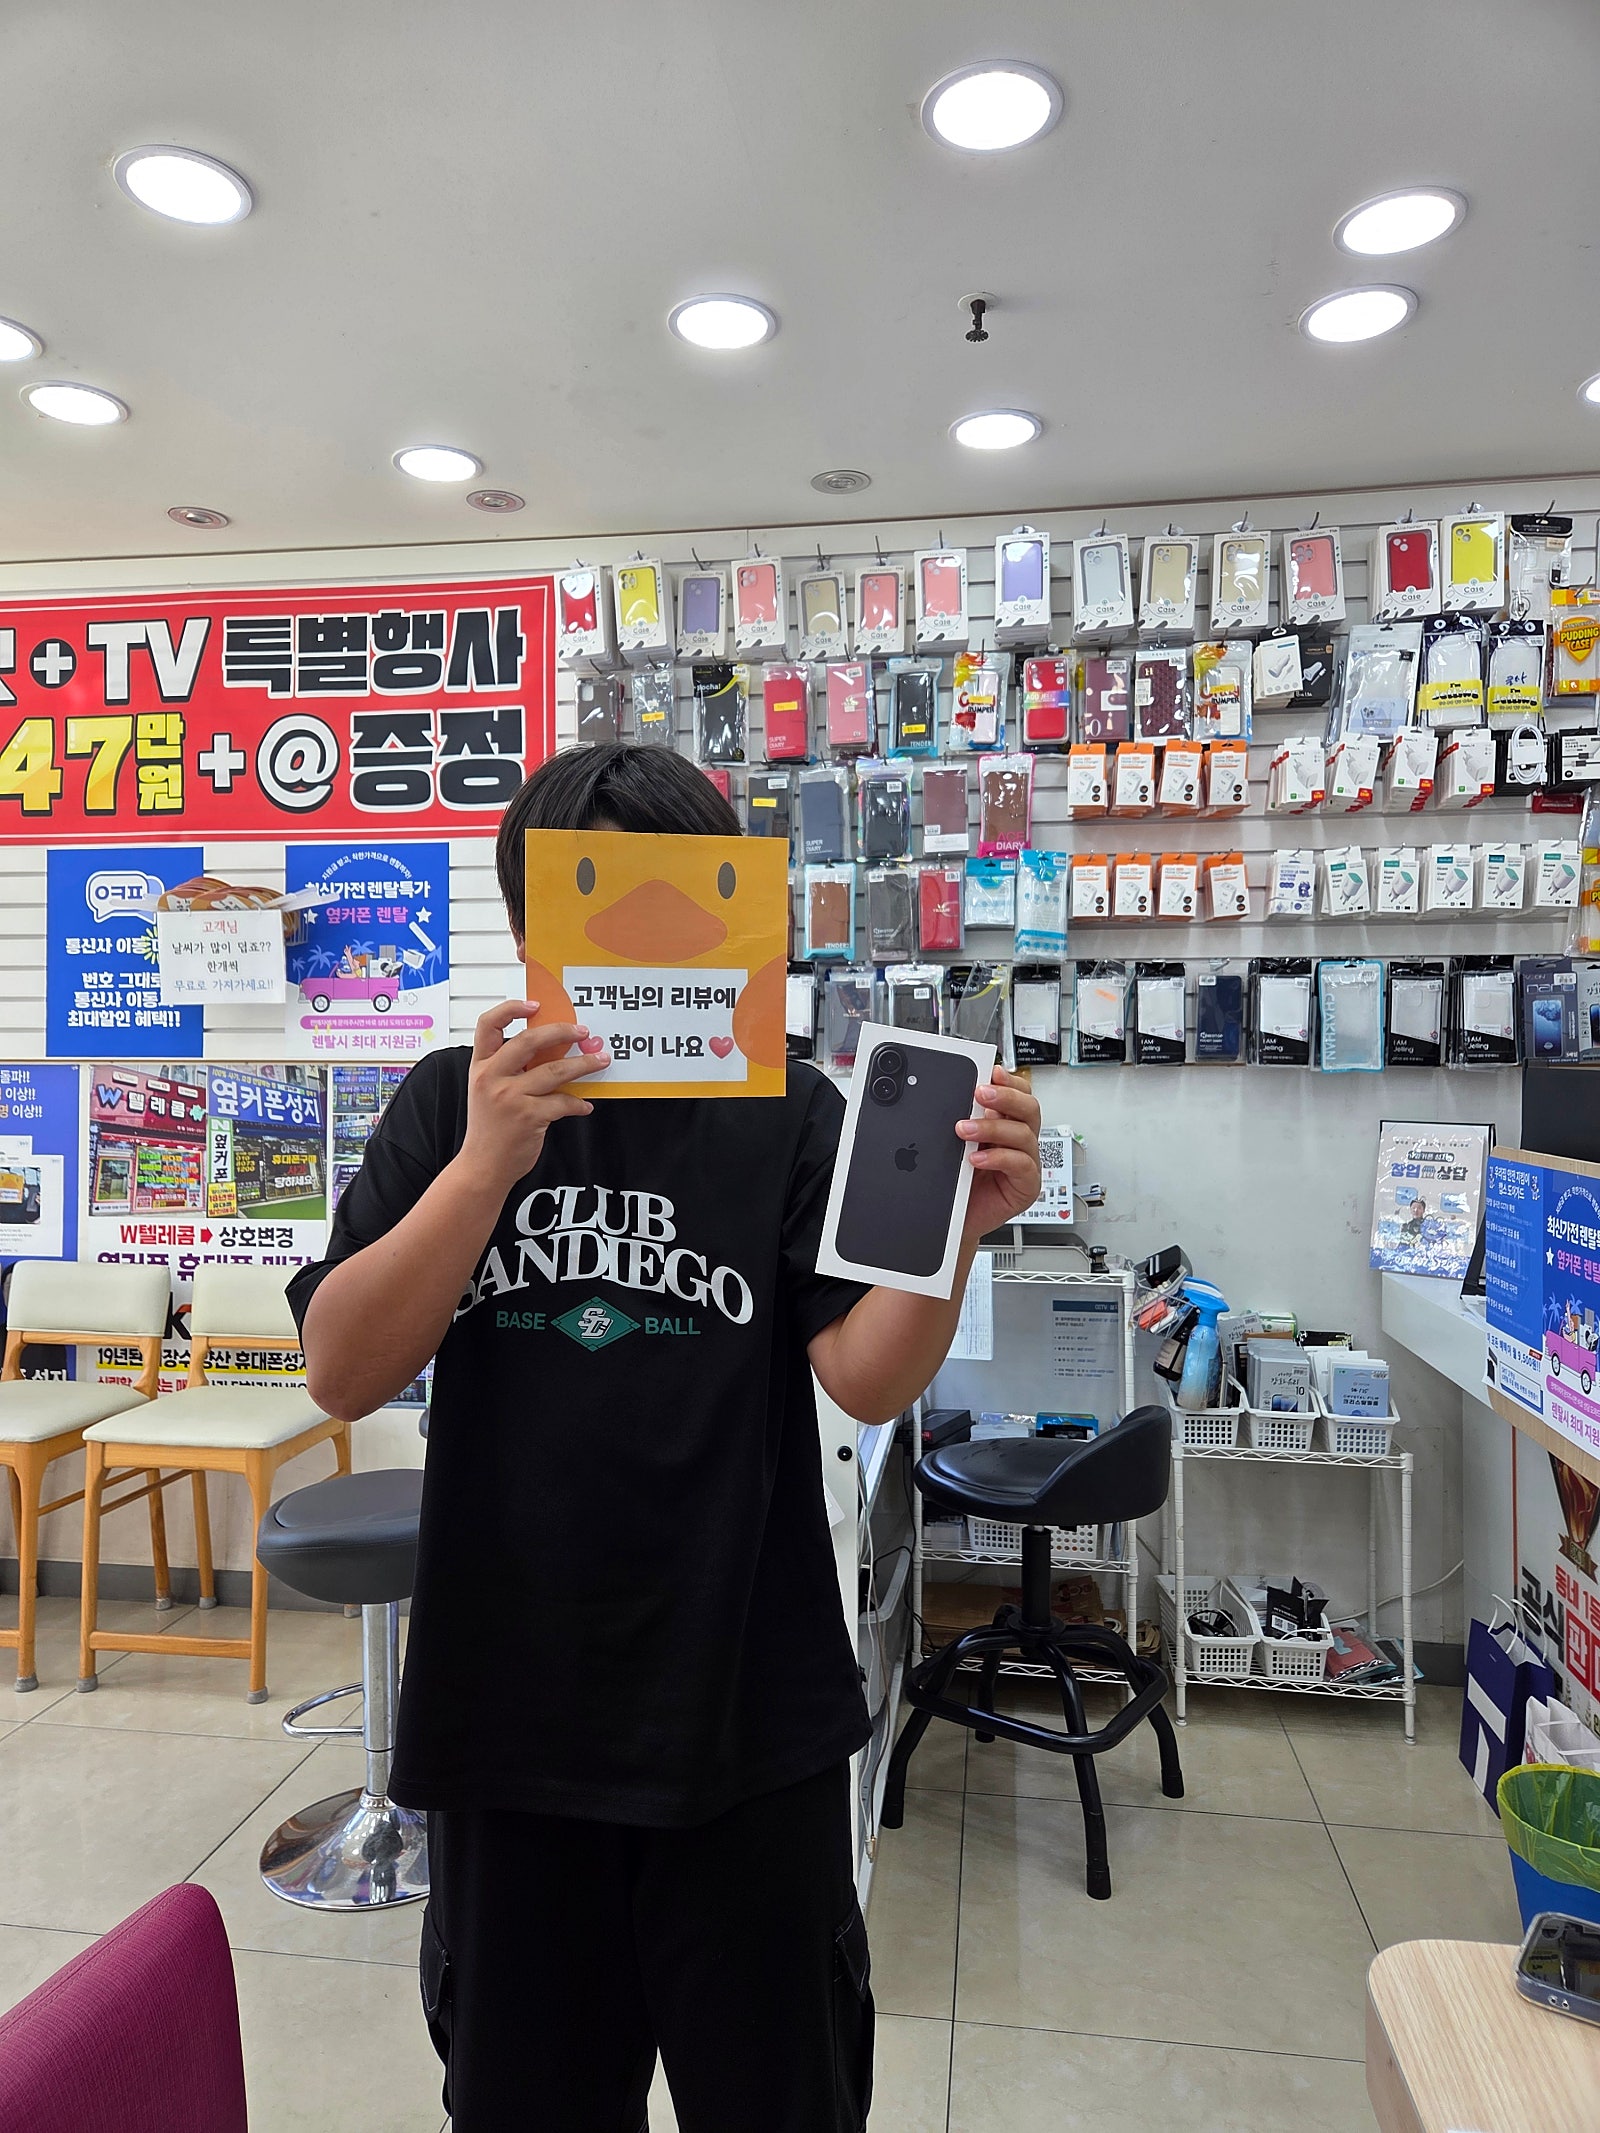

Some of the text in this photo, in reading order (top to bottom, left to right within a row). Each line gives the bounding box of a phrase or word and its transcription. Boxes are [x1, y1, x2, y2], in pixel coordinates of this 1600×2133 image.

[1463, 585, 1484, 594] Case
[1306, 600, 1327, 608] Case
[1401, 593, 1422, 602] Case
[1013, 603, 1032, 611] Case
[1096, 606, 1115, 615] Case
[1157, 606, 1176, 615] Case
[1231, 603, 1251, 612] Case
[751, 625, 768, 633] Case
[934, 618, 951, 627] Case
[633, 627, 650, 635] Case
[871, 631, 888, 640] Case
[1560, 627, 1600, 643] PUDDING
[572, 635, 589, 643] Case
[692, 636, 709, 644] Case
[815, 636, 832, 644] Case
[1570, 638, 1591, 652] CASE
[223, 608, 525, 699] 특별행사
[351, 706, 526, 811] 증정
[996, 841, 1025, 851] DIARY
[367, 880, 431, 898] 렌탈특가
[326, 906, 408, 924] 옆커폰 렌탈
[202, 920, 239, 934] 고객님
[65, 938, 113, 955] 통신사
[172, 942, 205, 955] 날씨가
[210, 942, 231, 954] 많이
[207, 960, 239, 973] 한개씩
[81, 972, 114, 989] 번호
[174, 981, 208, 992] 무료로
[74, 991, 122, 1009] 통신사
[572, 985, 737, 1011] 고객님의 리뷰에
[68, 1011, 181, 1028] 최대할인 혜택!!
[312, 1035, 421, 1049] 렌탈시 최대 지원금!
[608, 1032, 705, 1061] 힘이 나요
[6, 1087, 37, 1101] 이상!!
[211, 1078, 321, 1124] 옆커폰성지
[13, 1104, 43, 1119] 이상!!
[1391, 1163, 1469, 1181] 창업 상담
[515, 1184, 677, 1242] CLUB
[119, 1224, 294, 1249] W텔레콤 상호변경
[1547, 1214, 1579, 1245] 최신가전
[1557, 1249, 1581, 1277] 옆커폰
[496, 1310, 547, 1331] BASE
[644, 1316, 701, 1336] BALL
[1295, 1386, 1305, 1396] 10
[1551, 1401, 1569, 1428] 렌탈시
[1570, 1414, 1584, 1438] 최대
[1521, 1565, 1565, 1664] 공식
